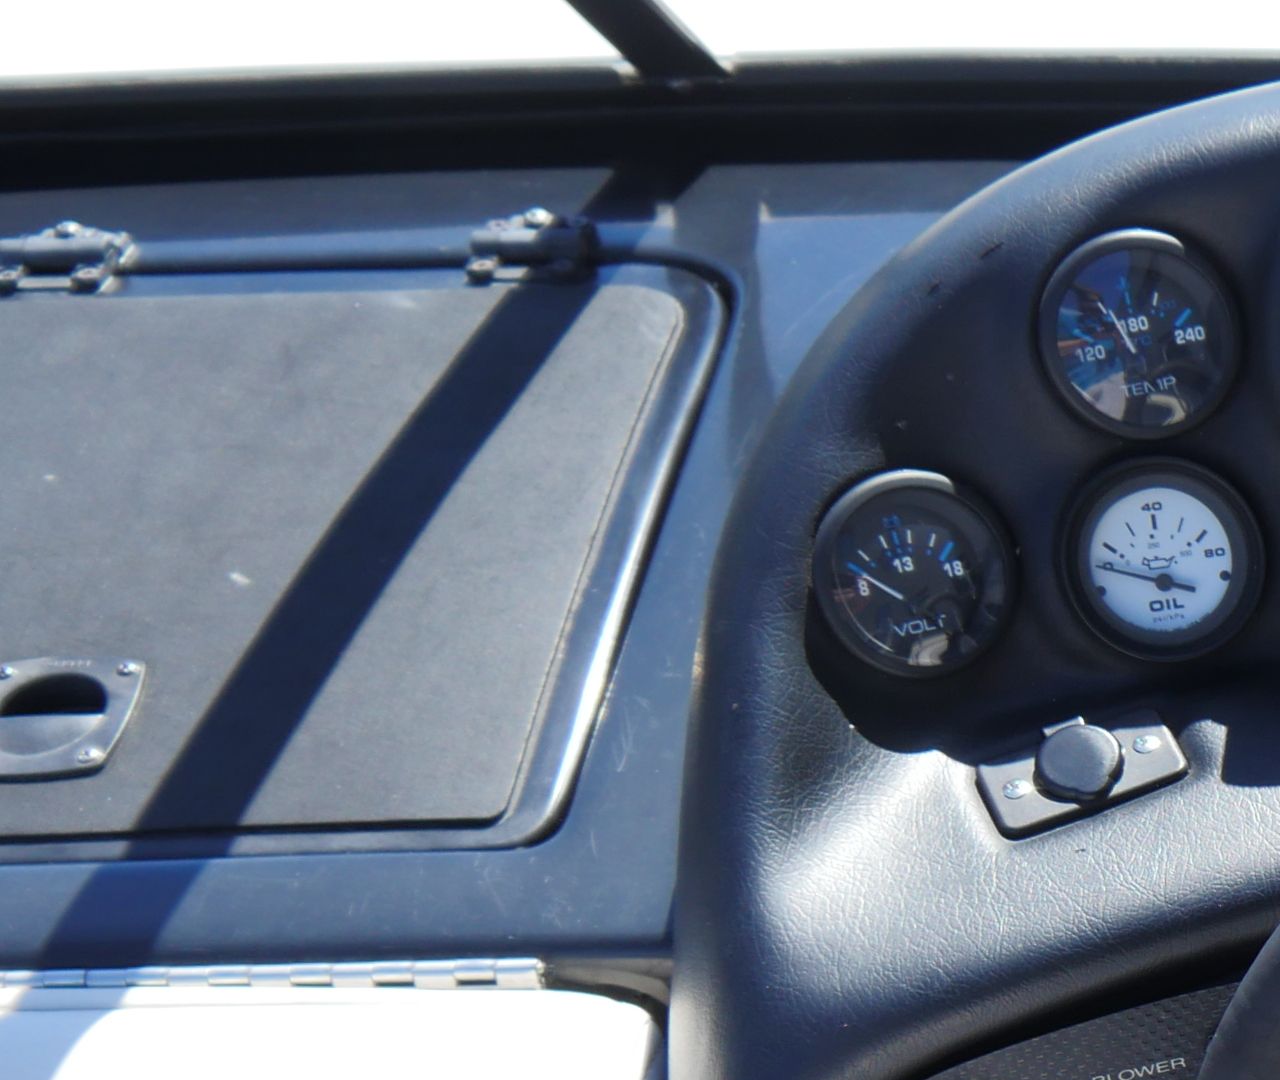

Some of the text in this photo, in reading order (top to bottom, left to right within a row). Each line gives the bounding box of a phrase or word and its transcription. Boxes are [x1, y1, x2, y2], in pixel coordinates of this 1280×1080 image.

[1174, 326, 1205, 344] 240
[1076, 345, 1105, 362] 120
[1141, 501, 1163, 512] 40
[1204, 548, 1226, 558] 80
[893, 556, 914, 573] 13
[943, 560, 964, 577] 18
[858, 580, 870, 596] 8
[1149, 598, 1185, 612] OIL
